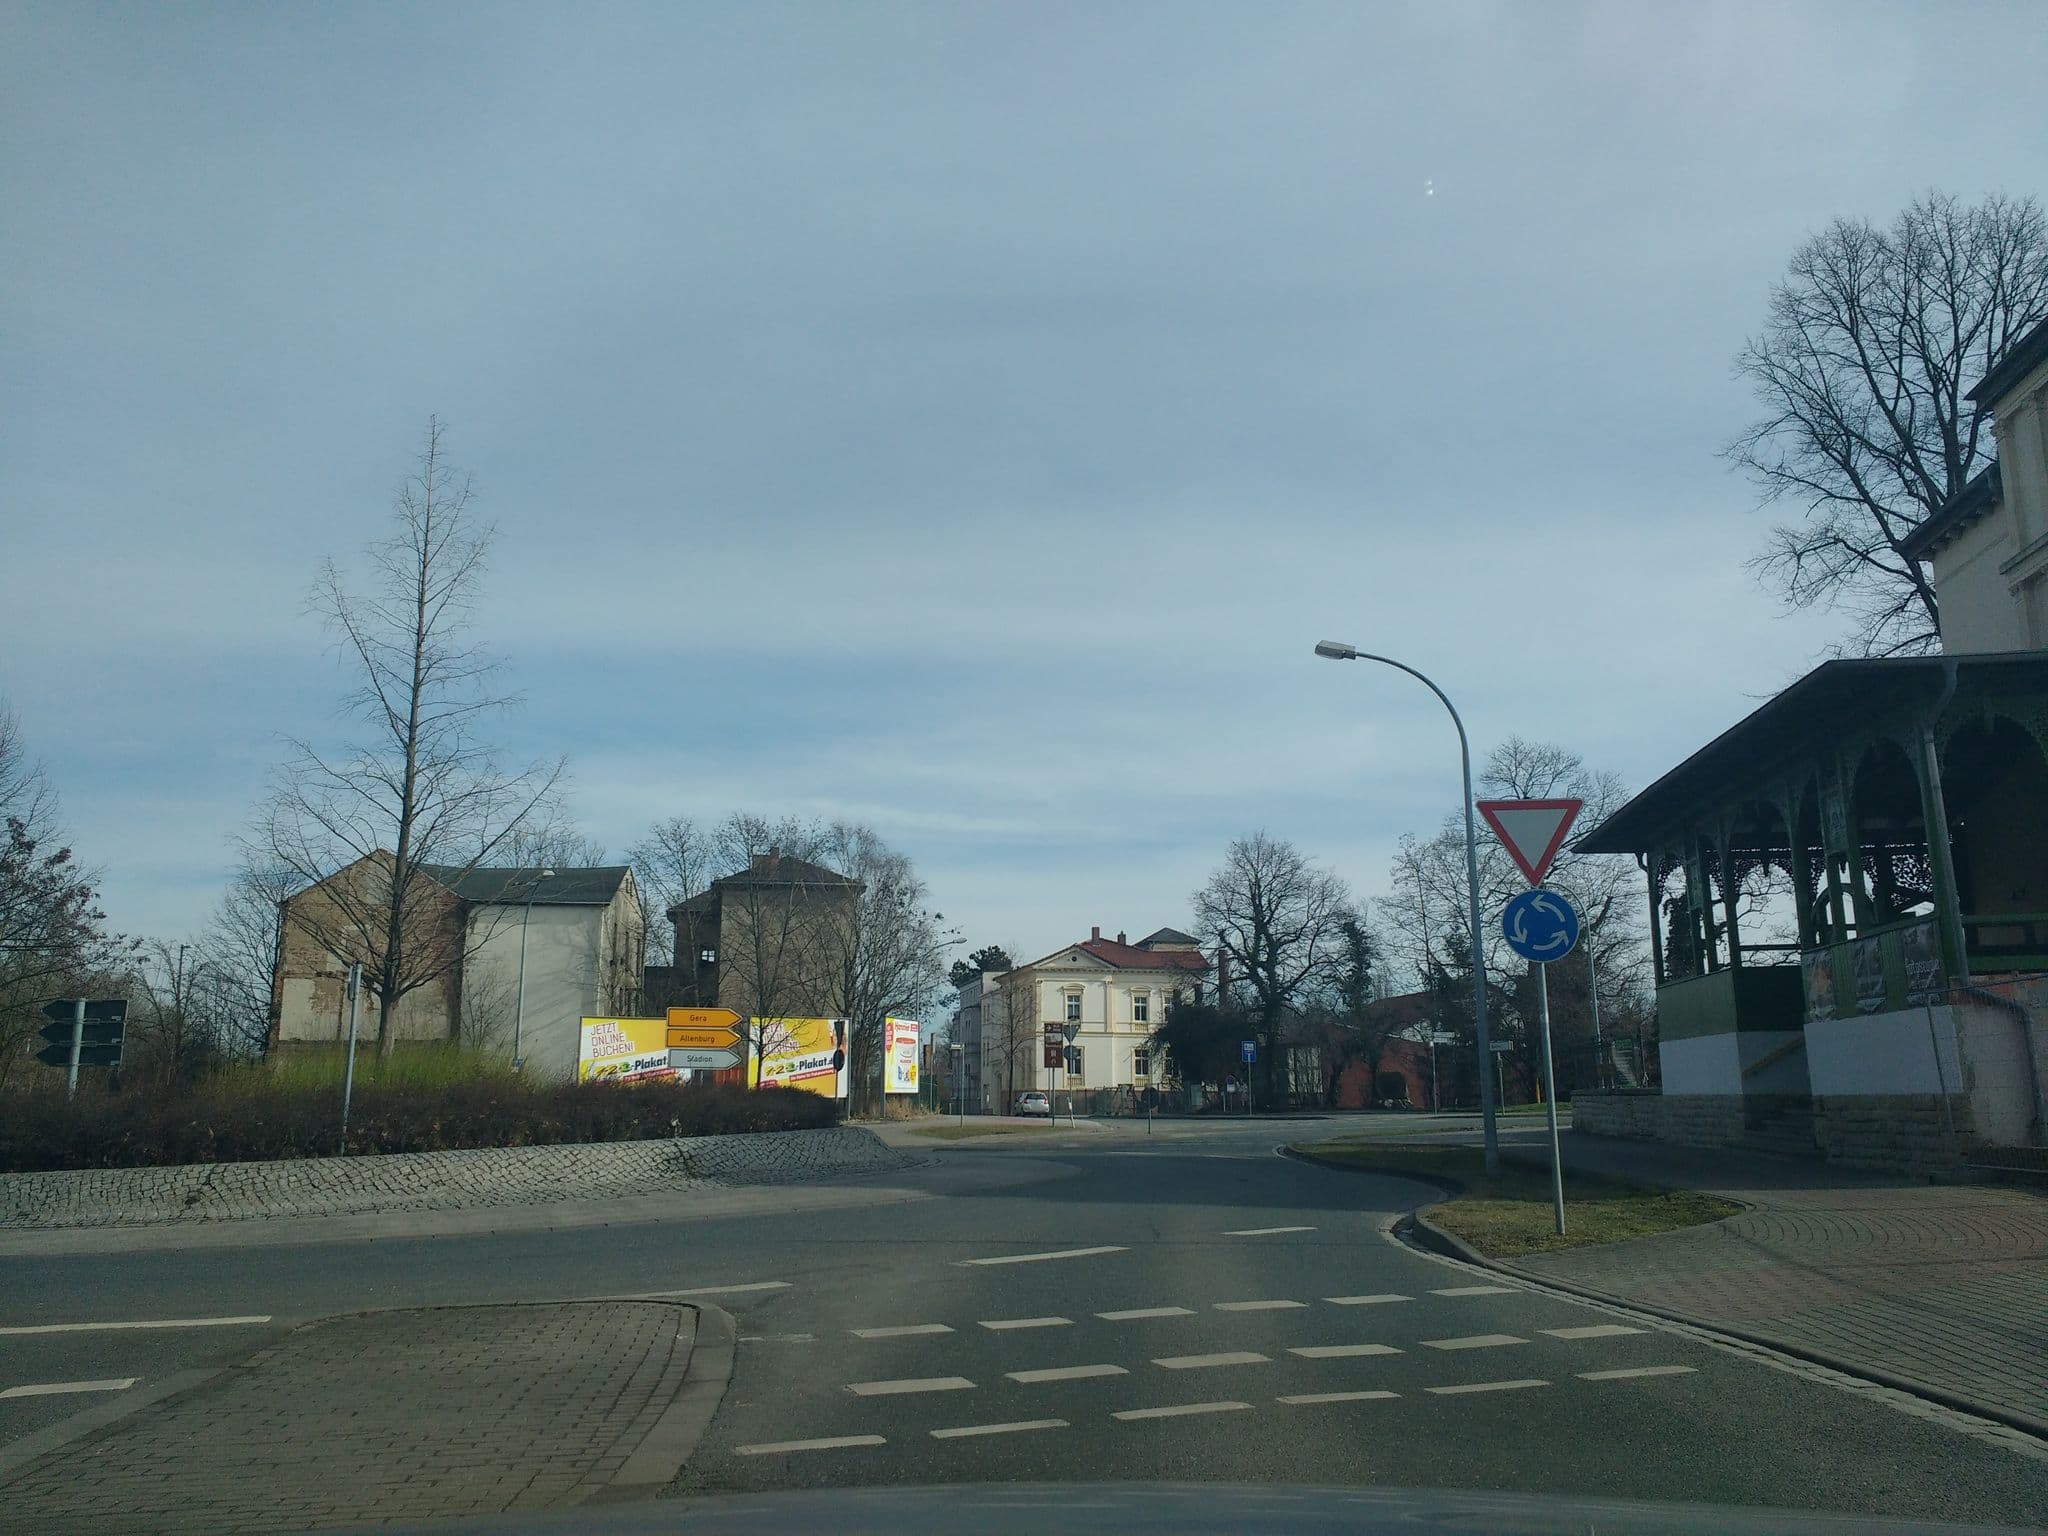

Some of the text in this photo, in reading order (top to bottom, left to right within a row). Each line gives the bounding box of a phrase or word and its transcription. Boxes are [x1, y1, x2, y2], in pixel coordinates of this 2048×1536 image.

[689, 1014, 707, 1022] Gera
[591, 1022, 616, 1036] JETZT
[591, 1032, 625, 1047] ONLINE
[680, 1034, 715, 1043] Altenburg
[592, 1042, 633, 1058] BUCHEN!
[687, 1054, 713, 1063] Stadion
